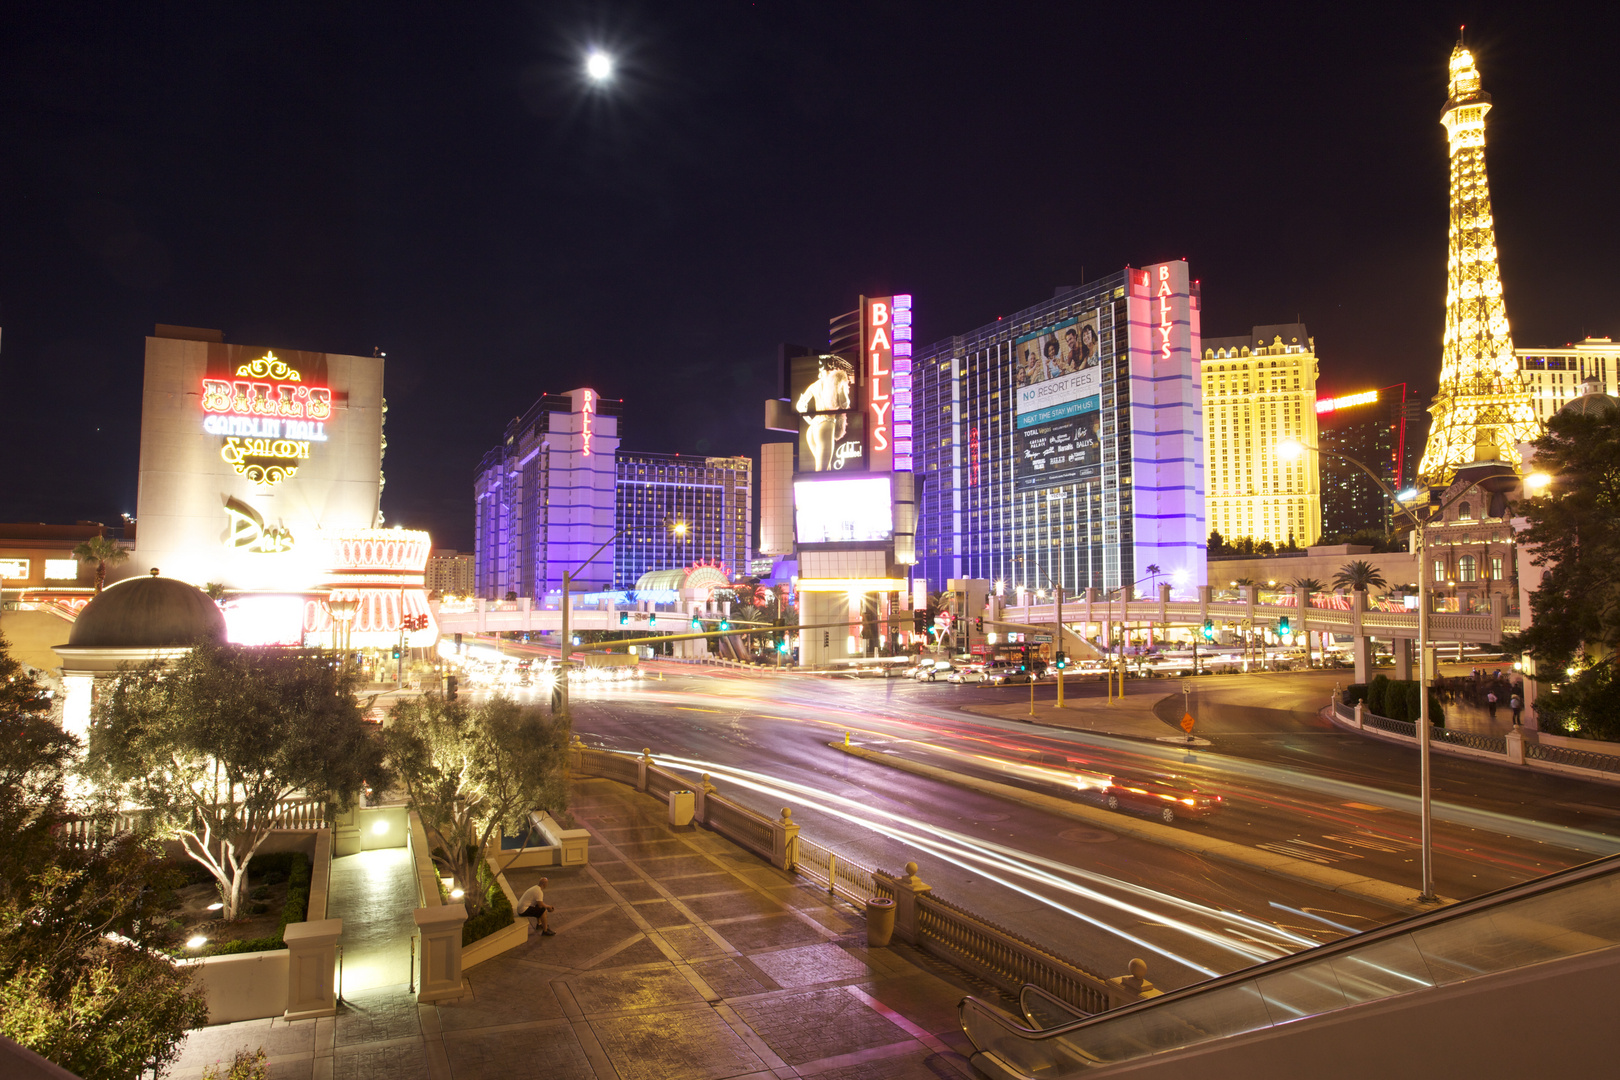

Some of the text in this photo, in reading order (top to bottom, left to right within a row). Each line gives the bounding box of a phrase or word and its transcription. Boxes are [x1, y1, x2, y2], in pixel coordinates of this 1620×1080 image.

[202, 378, 331, 420] BILL'S
[1023, 390, 1036, 401] NO
[1038, 380, 1068, 397] RESORT
[1070, 373, 1092, 388] FEES
[1023, 414, 1038, 424] NEXT
[1039, 412, 1051, 421] TIME
[1052, 408, 1066, 418] STAY
[1066, 404, 1082, 414] WITH
[1083, 400, 1093, 410] US!
[285, 419, 328, 441] HALL
[1024, 429, 1039, 437] TOTAL
[221, 437, 310, 464] & SALOON
